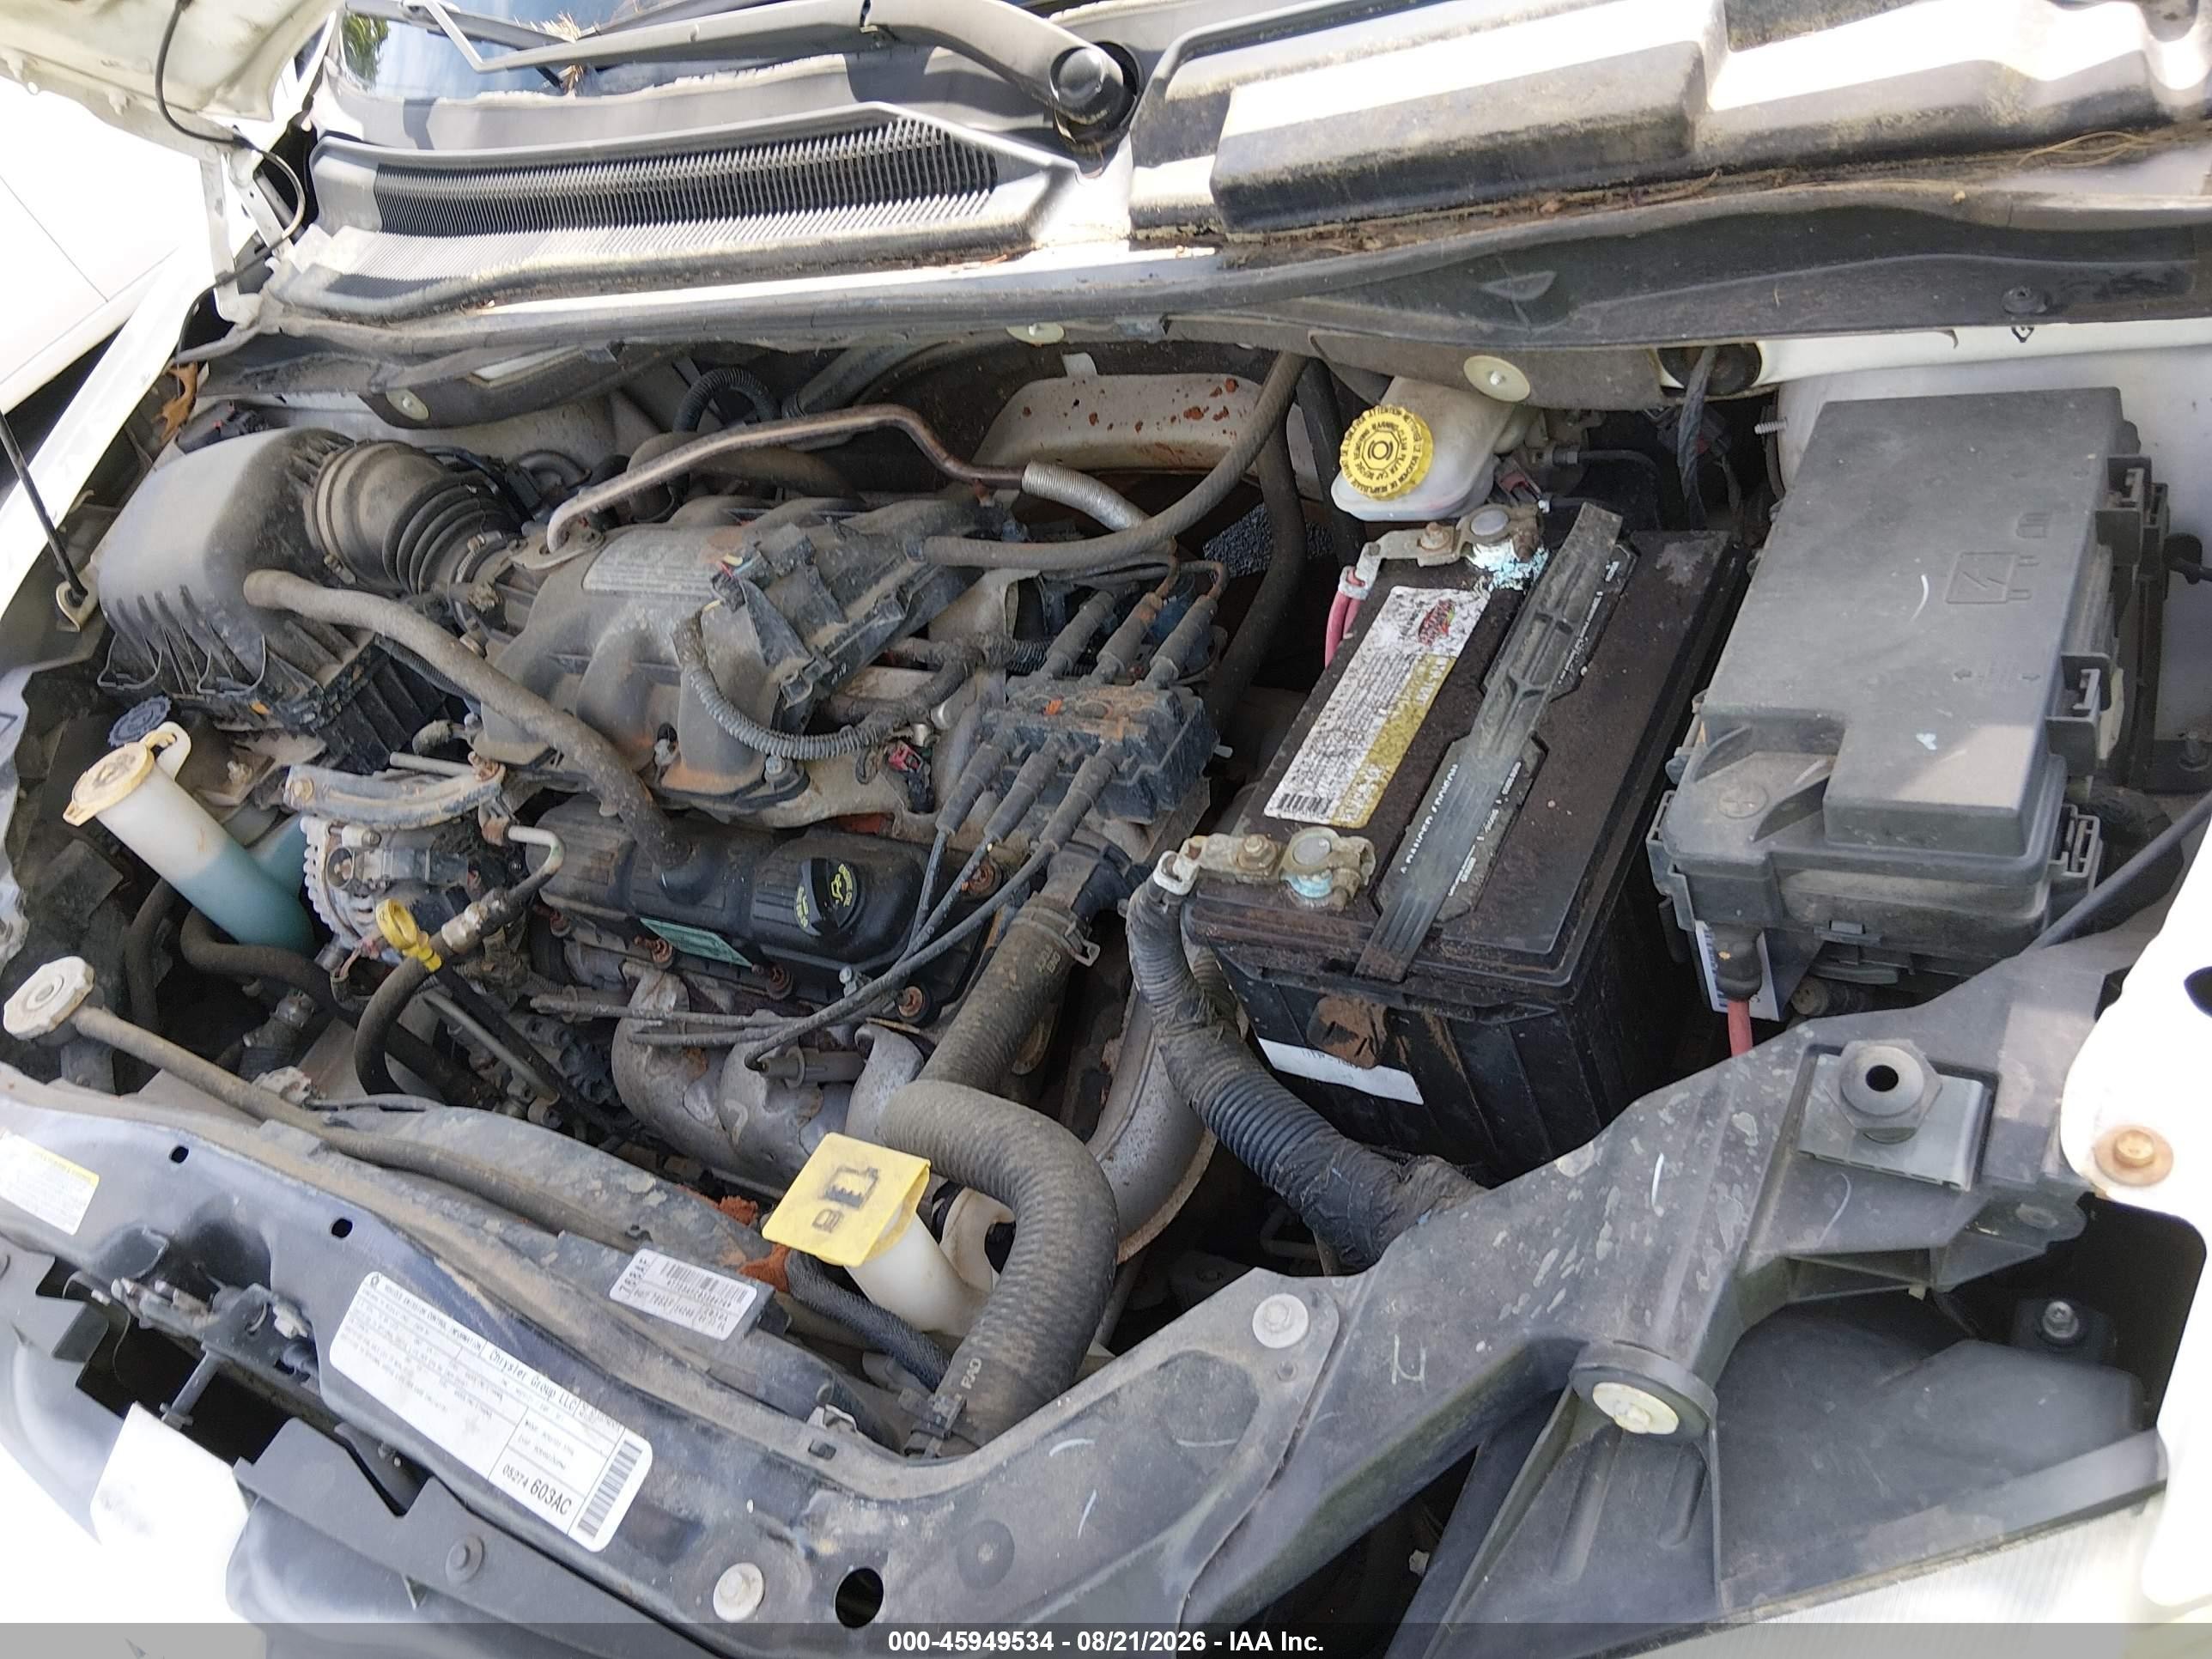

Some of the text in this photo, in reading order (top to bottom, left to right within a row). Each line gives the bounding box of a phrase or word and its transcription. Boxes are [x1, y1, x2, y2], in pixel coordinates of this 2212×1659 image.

[488, 1351, 527, 1382] Chrysler
[531, 1376, 557, 1401] Group
[558, 1390, 578, 1412] LLC
[501, 1463, 572, 1516] 05274 603AC
